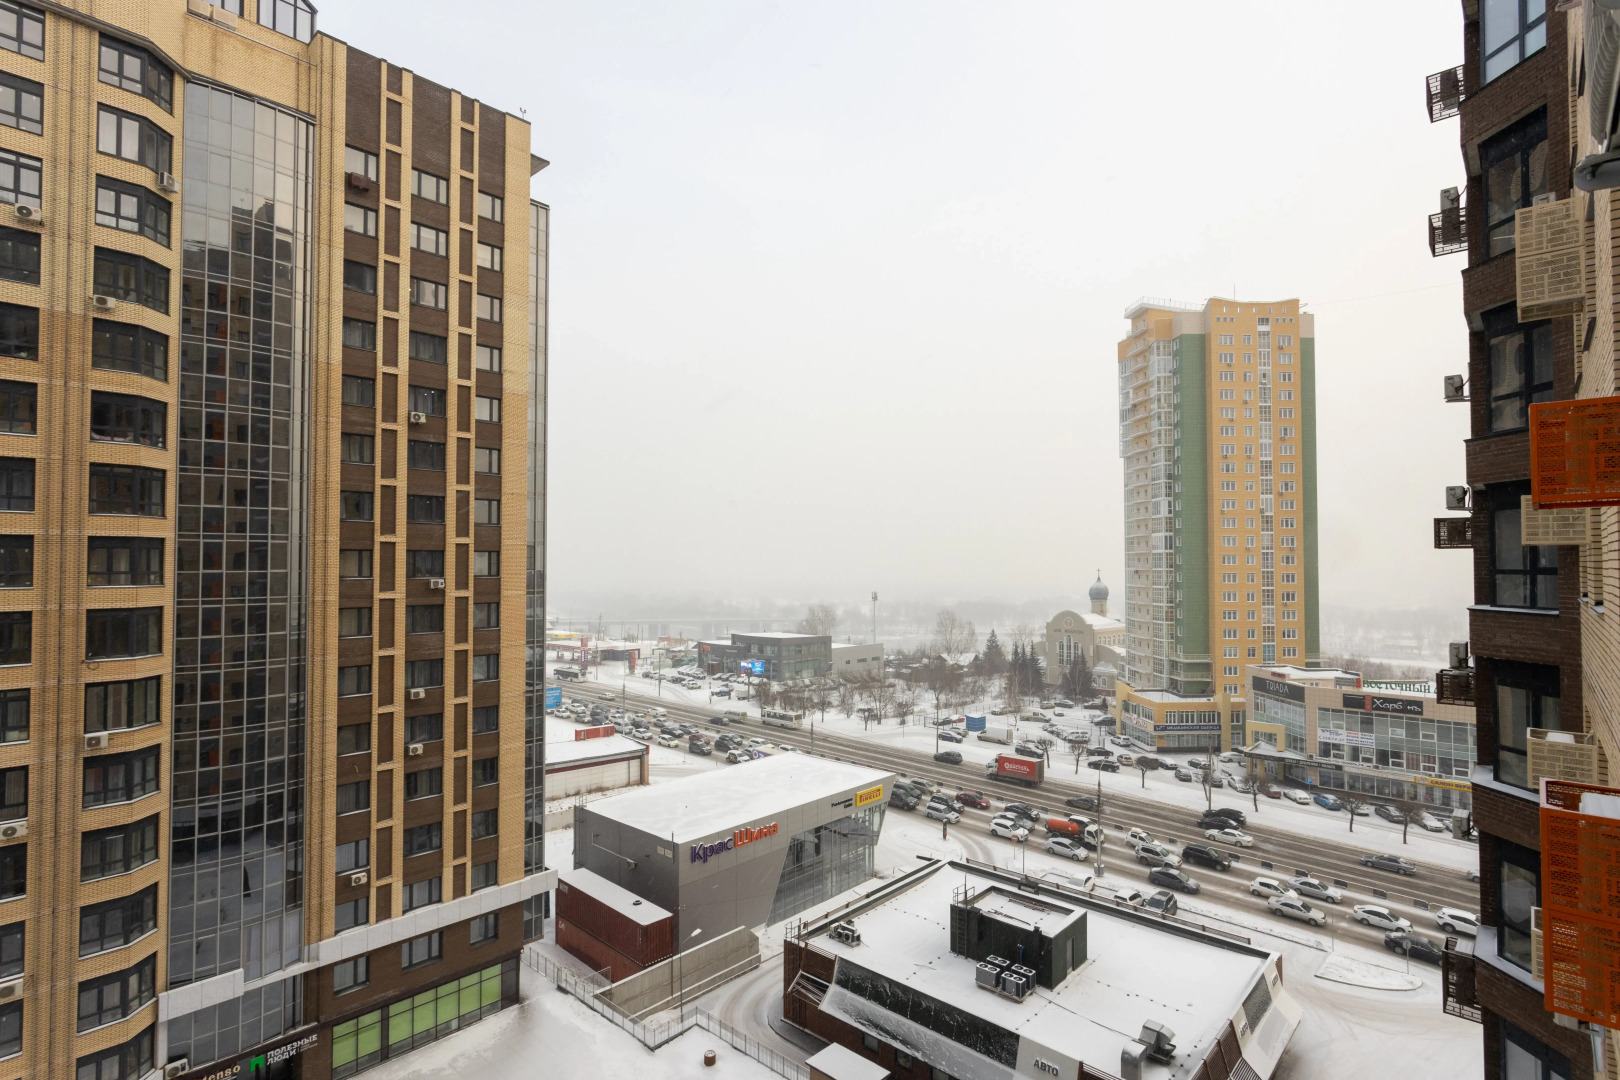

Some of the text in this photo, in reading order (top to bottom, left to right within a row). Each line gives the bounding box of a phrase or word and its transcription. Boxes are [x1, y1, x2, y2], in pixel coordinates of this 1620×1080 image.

[1265, 680, 1290, 695] TRIADA
[859, 788, 881, 803] PIRELLI
[266, 1033, 318, 1060] ПОЛЕЗНЫЕ
[266, 1048, 297, 1066] ЛЮДИ
[1033, 1058, 1059, 1077] АВТО
